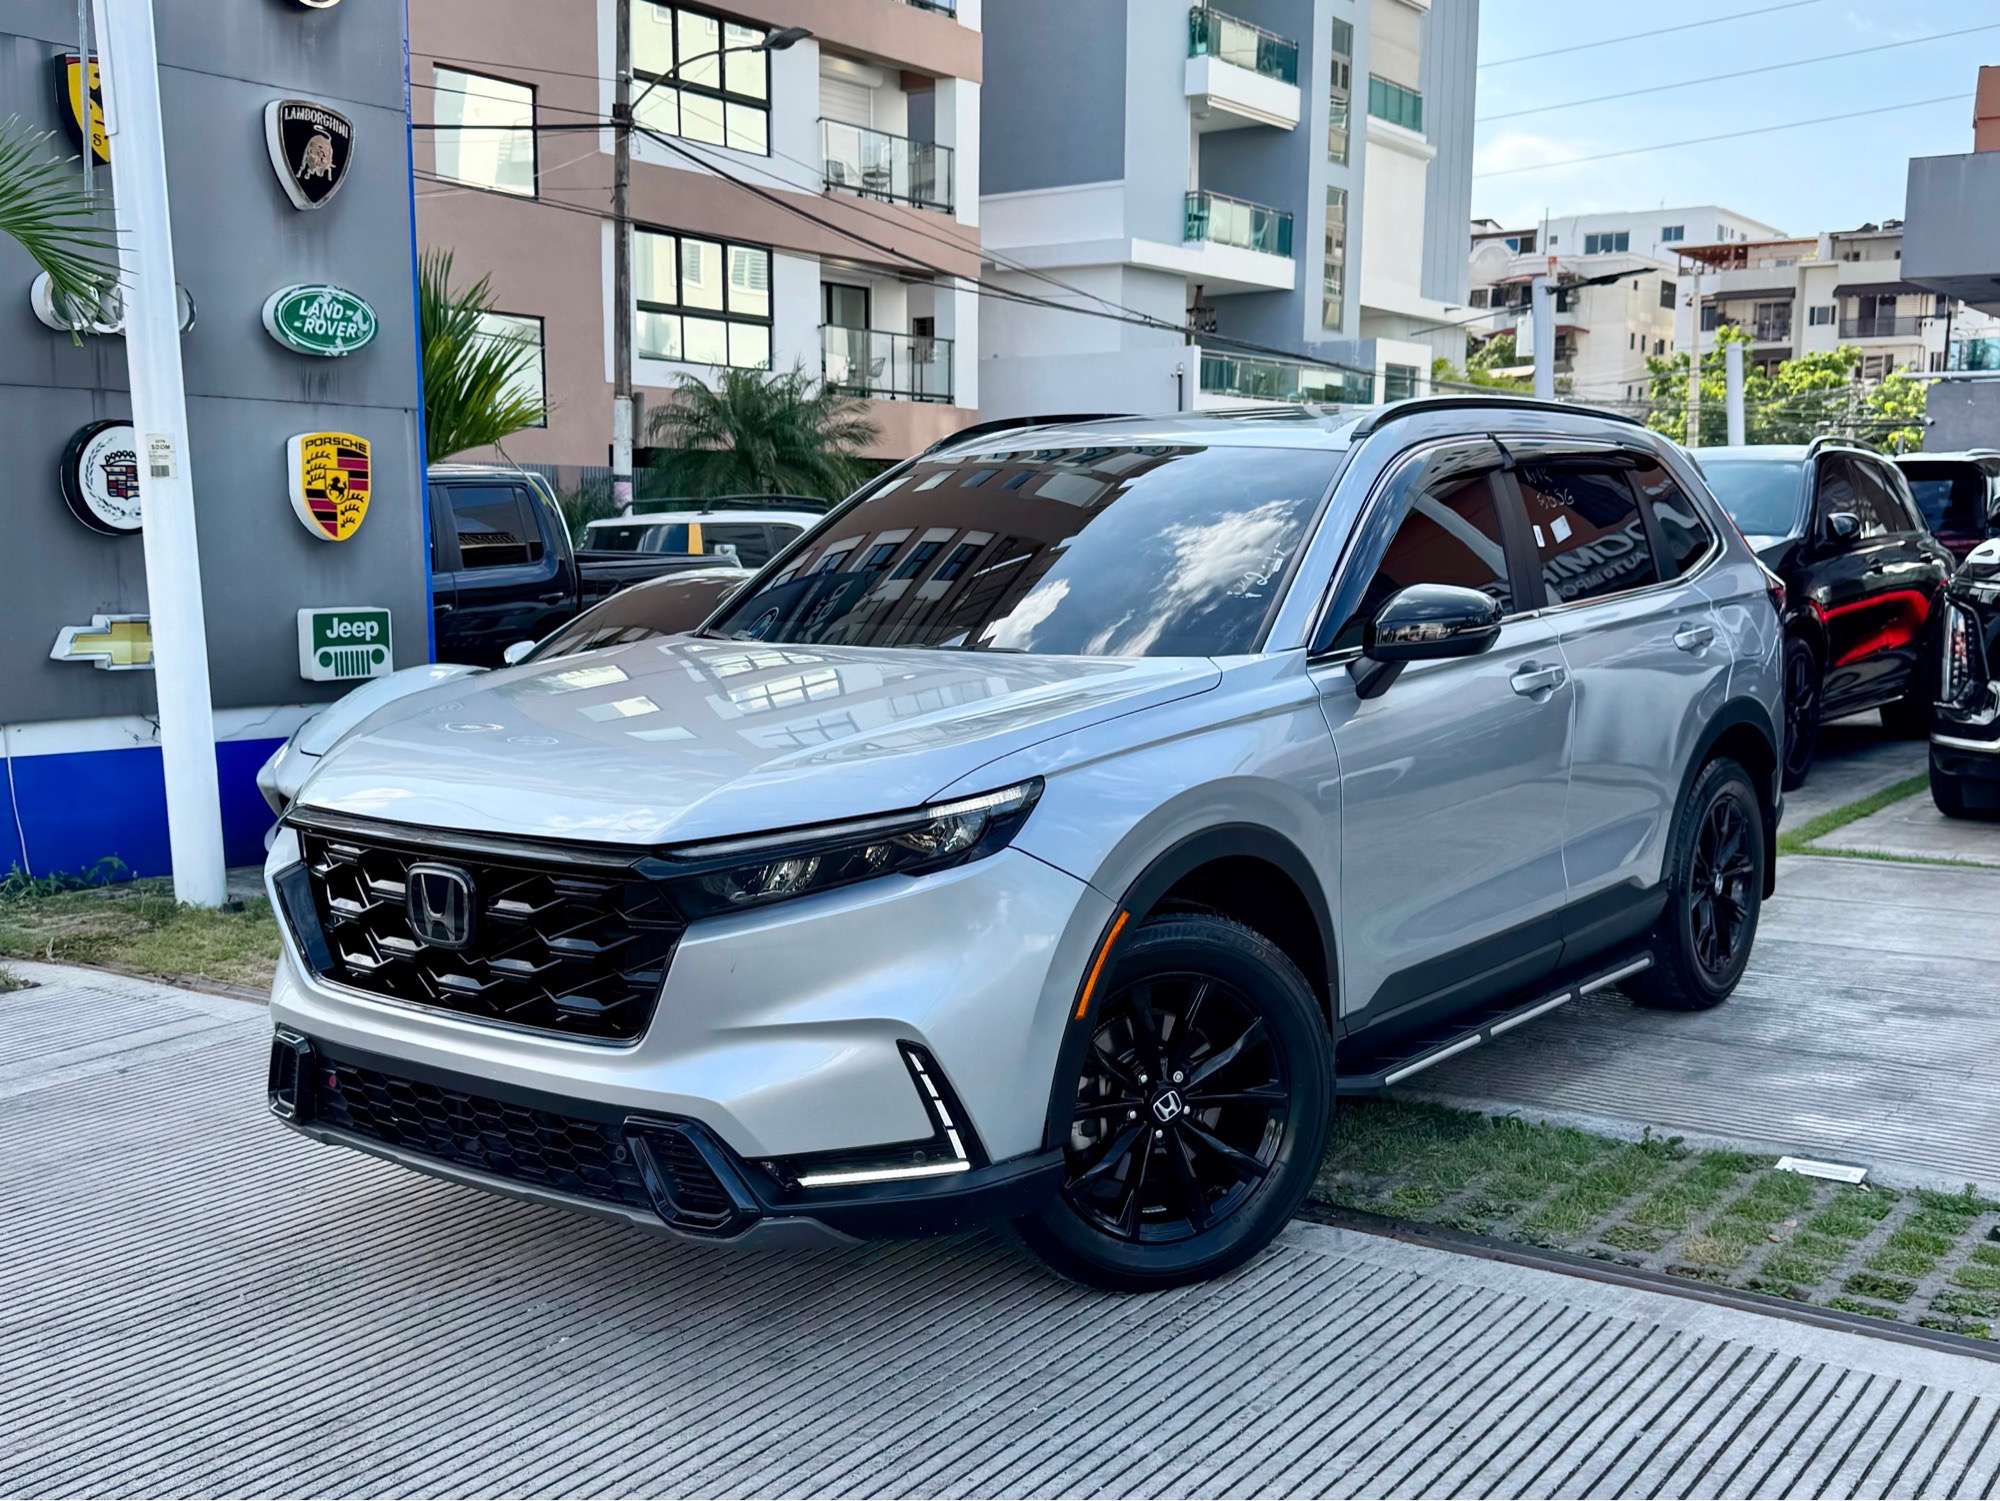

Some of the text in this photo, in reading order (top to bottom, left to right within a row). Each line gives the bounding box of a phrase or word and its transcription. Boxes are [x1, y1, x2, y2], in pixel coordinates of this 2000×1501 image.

[284, 106, 349, 139] LAMBORGHINI
[305, 437, 367, 454] PORSCHE
[325, 616, 379, 641] Jeep
